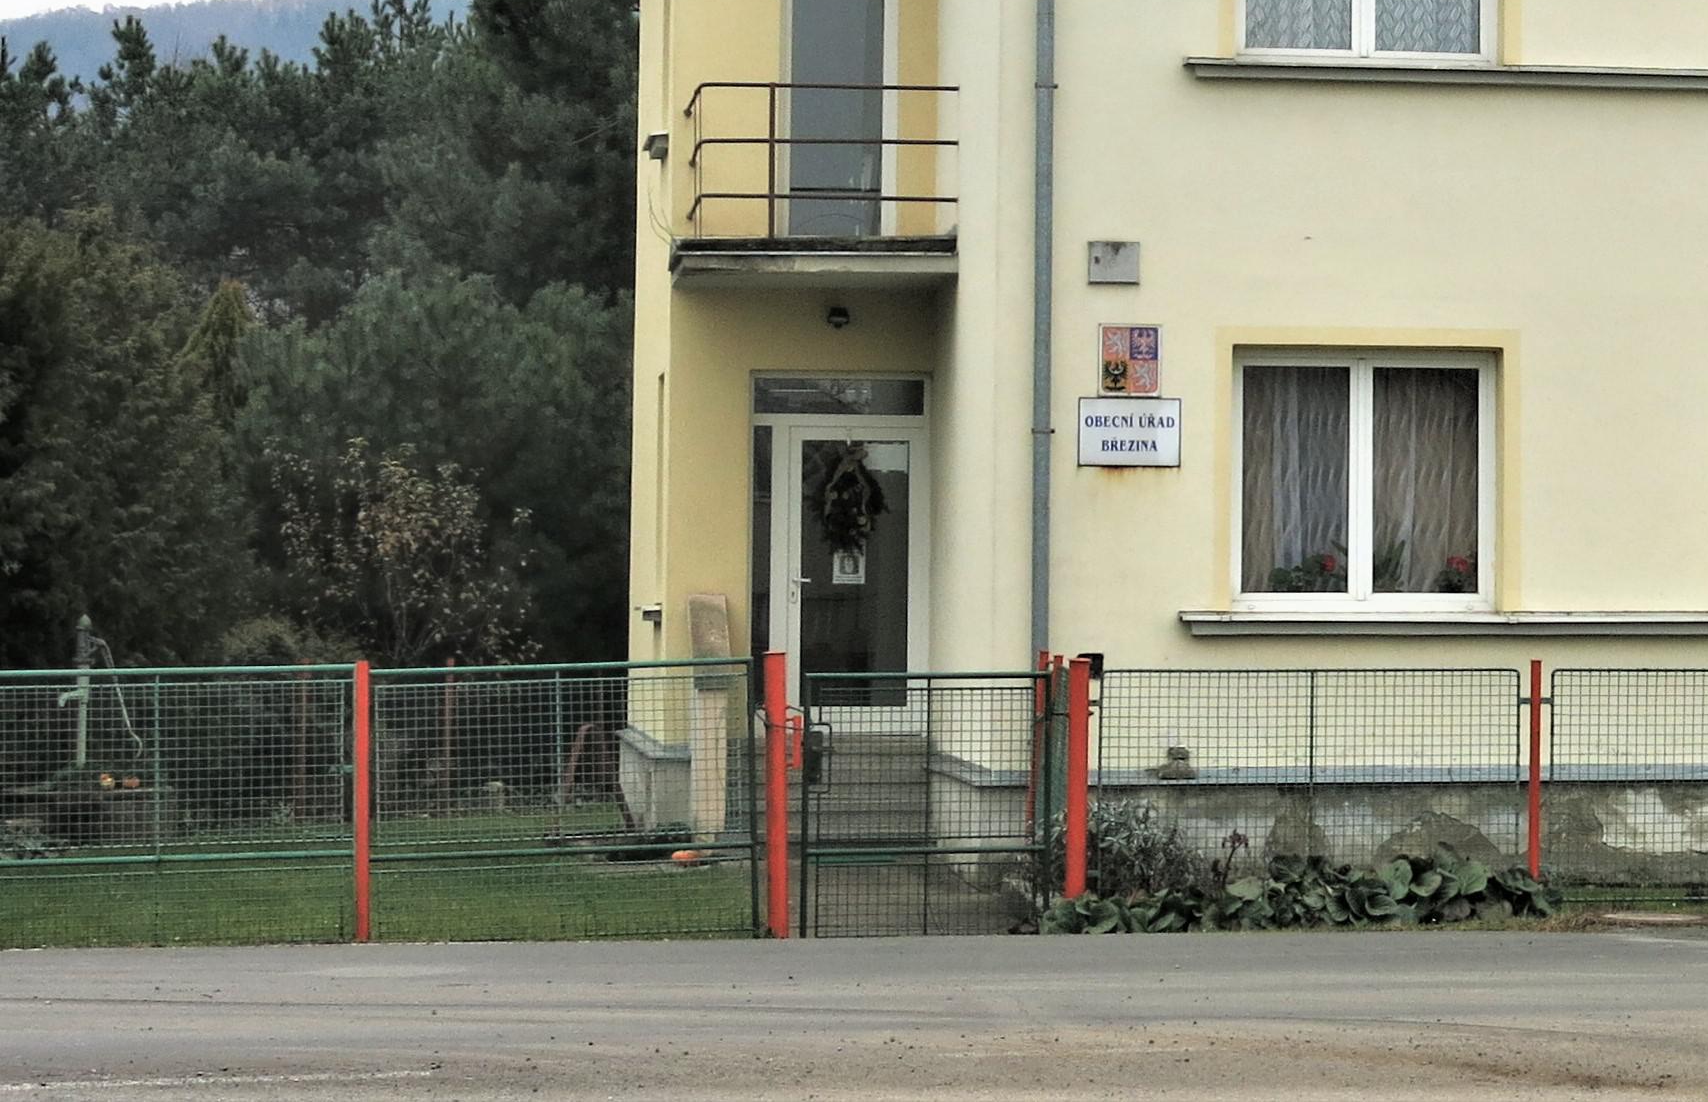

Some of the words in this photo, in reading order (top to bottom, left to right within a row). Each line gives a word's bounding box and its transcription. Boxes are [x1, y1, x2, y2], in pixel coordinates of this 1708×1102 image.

[1084, 413, 1134, 428] OBECNÍ
[1138, 413, 1176, 428] ÚŘAD
[1101, 437, 1159, 452] BŘEZINA
